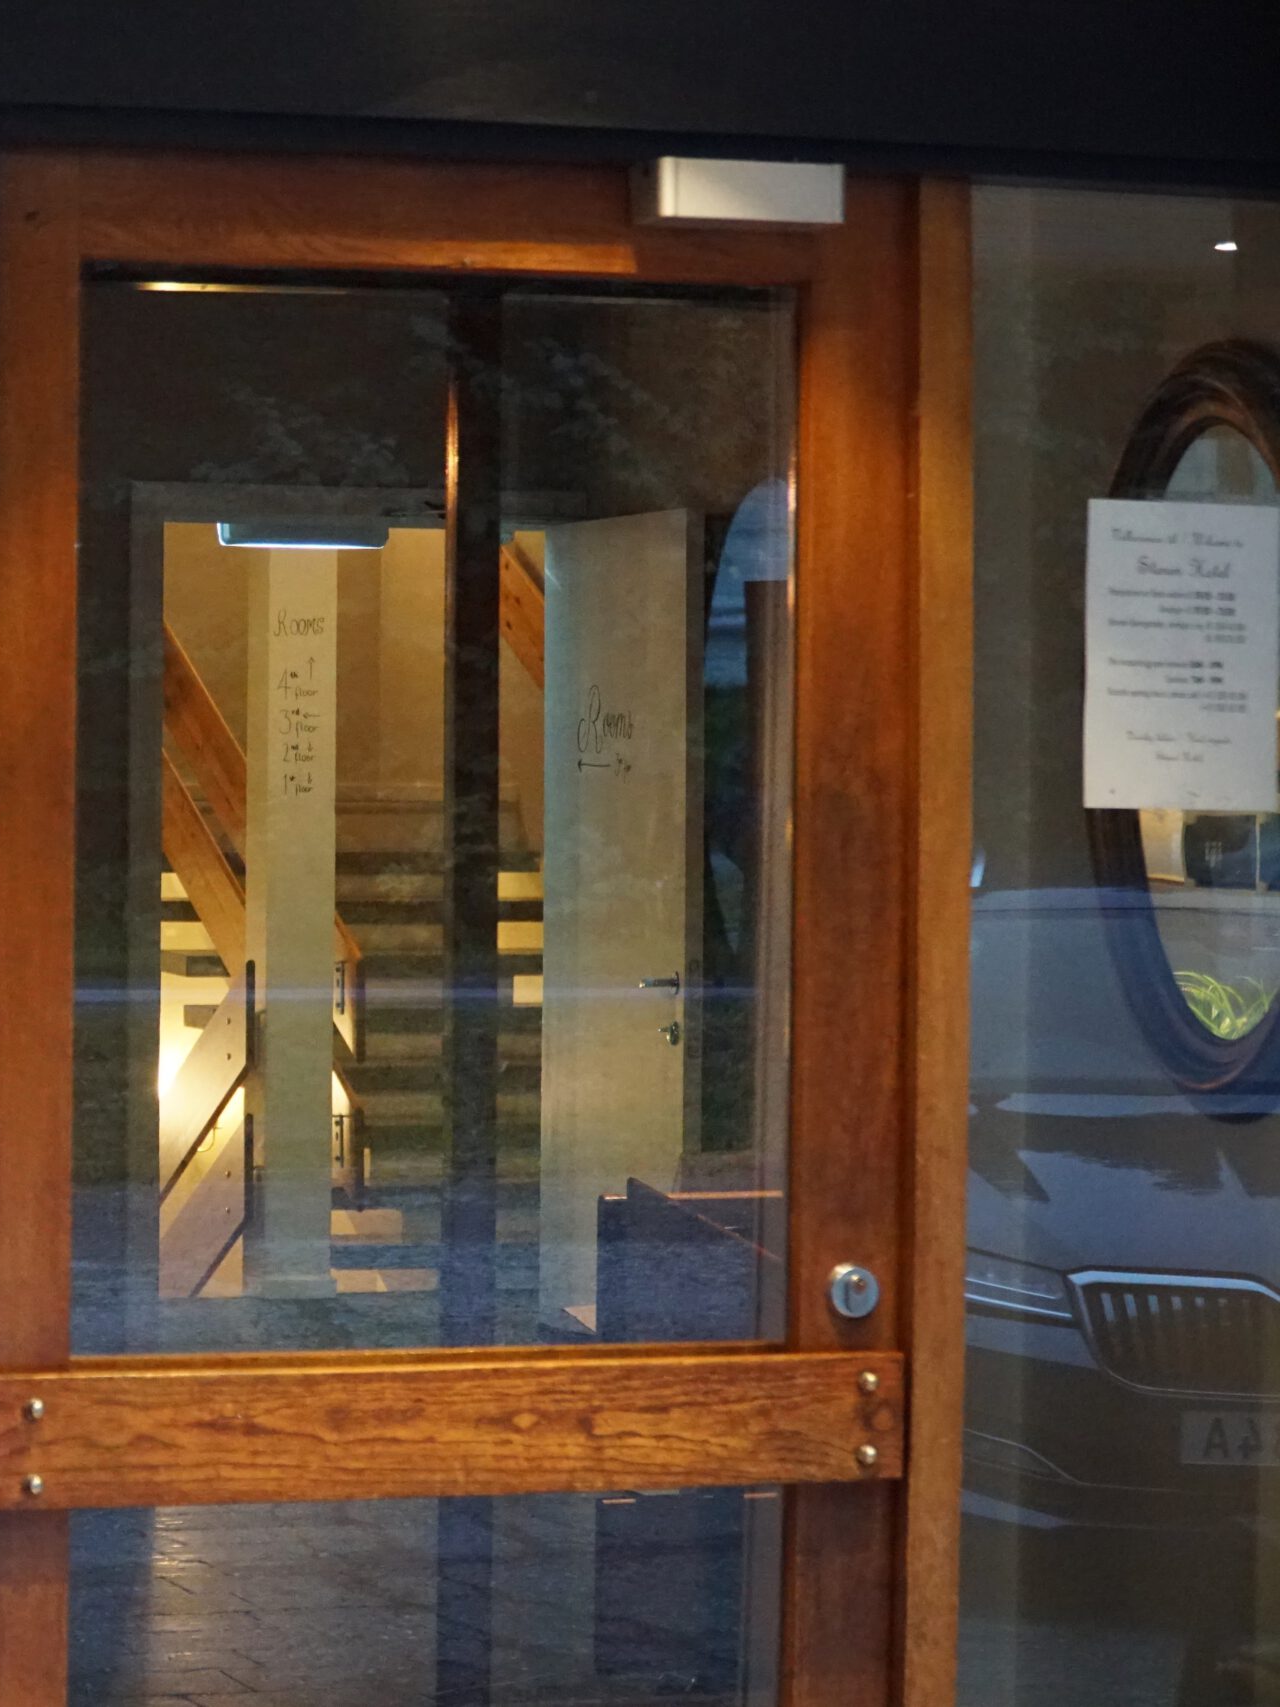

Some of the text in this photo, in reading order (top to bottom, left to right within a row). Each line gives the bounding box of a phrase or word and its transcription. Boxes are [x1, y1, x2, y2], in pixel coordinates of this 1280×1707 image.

[294, 686, 319, 700] floor
[295, 720, 319, 739] floor
[294, 751, 314, 765] floor
[294, 783, 313, 797] floor
